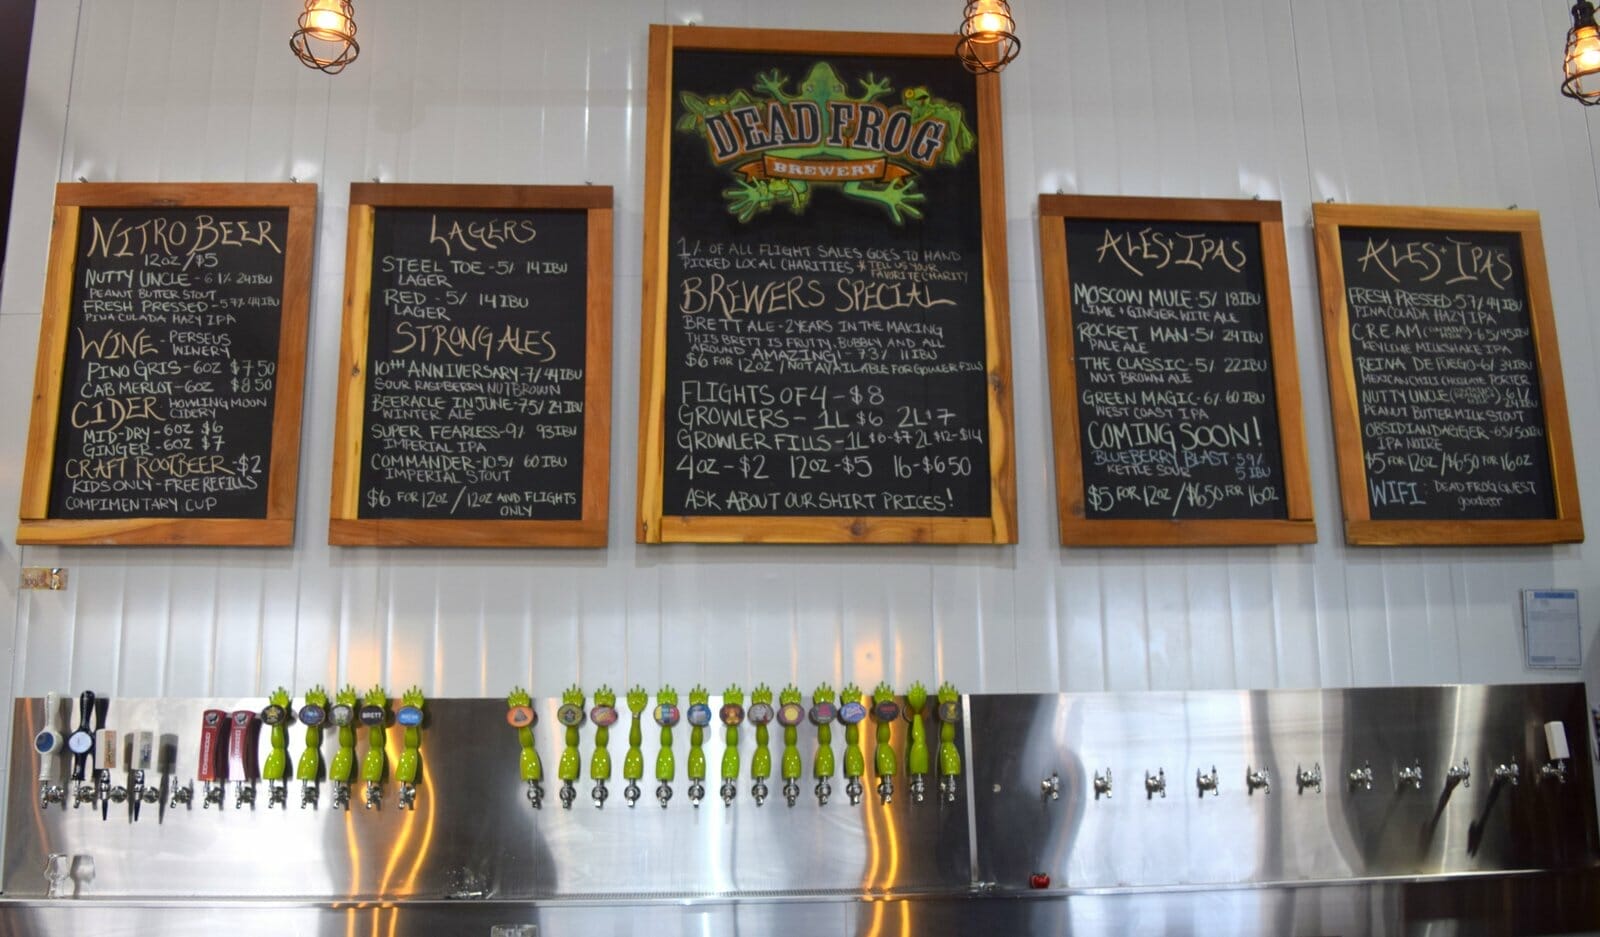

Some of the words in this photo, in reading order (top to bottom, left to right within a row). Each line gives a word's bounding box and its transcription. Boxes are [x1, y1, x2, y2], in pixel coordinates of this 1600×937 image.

[705, 102, 824, 161] DEAD
[827, 102, 946, 162] FROG
[773, 162, 879, 177] BREWERY
[87, 216, 186, 257] NITRO
[185, 215, 282, 256] BEER
[430, 214, 536, 256] LAGERS
[710, 244, 723, 254] OF
[729, 243, 752, 255] ALL
[759, 244, 811, 257] FLIGHT
[816, 246, 862, 258] SALES
[866, 248, 900, 261] GOES
[902, 250, 918, 260] TO
[924, 250, 962, 261] HAND
[1097, 227, 1170, 277] ALES
[1175, 231, 1246, 273] IPAS
[382, 256, 443, 273] STEEL
[451, 261, 485, 274] TOE
[682, 258, 731, 269] PICKED
[735, 258, 775, 269] LOCAL
[781, 259, 854, 273] CHARITIES
[85, 269, 133, 288] NUTTY
[140, 271, 191, 287] UNCLE
[398, 274, 452, 288] LAGER
[90, 290, 132, 299] PEANUT
[138, 290, 179, 299] BUTTER
[183, 290, 216, 300] STOUT
[384, 289, 426, 305] RED
[680, 273, 825, 321] BREWERS
[835, 276, 958, 312] SPECIAL
[1074, 283, 1141, 305] MOSCOW
[1149, 289, 1191, 308] MULE
[1349, 288, 1391, 304] FRESH
[1394, 289, 1451, 309] PRESSED
[83, 300, 132, 312] FRESH
[142, 301, 208, 313] PRESSED
[394, 305, 450, 320] LAGER
[1081, 305, 1115, 318] LIME
[1127, 307, 1174, 321] GINGER
[1213, 312, 1240, 324] ALE
[173, 315, 202, 326] HAZY
[207, 314, 236, 325] IPA
[1388, 307, 1430, 321] COLADA
[1434, 309, 1466, 325] HAZY
[1469, 312, 1497, 324] IPA
[683, 315, 743, 333] BRETT
[747, 321, 775, 332] ALE
[838, 321, 856, 332] IN
[886, 322, 944, 338] MAKING
[1077, 323, 1138, 342] ROCKET
[1151, 327, 1188, 344] MAN
[1352, 324, 1420, 340] CREAM
[78, 327, 159, 360] WINE
[169, 331, 231, 346] PERSEUS
[392, 322, 494, 360] STRONG
[497, 325, 557, 363] ALES
[685, 332, 719, 344] THIS
[721, 335, 761, 347] BRETT
[767, 338, 783, 347] IS
[838, 336, 882, 348] BUBBLY
[886, 338, 916, 348] AND
[922, 338, 946, 348] ALL
[1090, 339, 1120, 352] PALE
[1123, 343, 1149, 354] ALE
[172, 344, 230, 357] WINERY
[690, 344, 745, 354] AROUND
[1486, 345, 1512, 354] IPA
[87, 362, 130, 382] PINO
[134, 361, 181, 381] GRIS
[408, 361, 521, 381] ANNIVERSARY
[685, 352, 708, 368] $6
[713, 356, 733, 366] FOR
[814, 362, 890, 375] AVAILABLE
[1080, 356, 1110, 371] THE
[1116, 357, 1186, 372] CLASSIC
[1356, 356, 1406, 372] REINA
[1412, 356, 1432, 370] DE
[374, 378, 411, 390] SOUR
[1090, 373, 1116, 383] NUT
[1121, 374, 1164, 384] BROWN
[1168, 374, 1192, 383] ALE
[1488, 374, 1531, 386] PORTER
[81, 382, 113, 398] CAB
[119, 382, 173, 395] MERLOT
[681, 381, 775, 404] FLIGHTS
[780, 386, 807, 406] OF
[809, 386, 827, 409] 4
[1083, 389, 1136, 406] GREEN
[1142, 391, 1197, 406] MAGIC
[1363, 390, 1407, 403] NUTTY
[1409, 390, 1449, 402] UNCLE
[169, 398, 229, 410] HOWLING
[231, 398, 267, 407] MOON
[372, 394, 446, 412] BEERACLE
[452, 399, 474, 411] IN
[475, 398, 513, 412] JUNE
[71, 396, 166, 431] CIDER
[170, 408, 216, 419] CIDERY
[382, 410, 441, 420] WINTER
[448, 410, 476, 420] ALE
[678, 404, 789, 430] GROWLERS
[856, 411, 883, 426] $6
[1096, 406, 1129, 418] WEST
[1134, 408, 1173, 418] COAST
[1178, 408, 1209, 419] IPA
[1363, 405, 1408, 417] PEANUT
[1487, 411, 1525, 422] STOUT
[202, 422, 223, 435] $6
[371, 424, 422, 439] SUPER
[431, 425, 500, 439] FEARLESS
[1087, 421, 1178, 451] COMING
[1180, 416, 1262, 450] SOON!
[1366, 423, 1430, 436] OBSIDIAN
[83, 443, 153, 459] GINGER
[202, 436, 225, 451] $7
[383, 439, 452, 452] IMPERIAL
[458, 442, 487, 452] IPA
[677, 430, 772, 452] GROWLER
[775, 434, 831, 451] FILLS
[1377, 437, 1402, 449] IPA
[1407, 437, 1443, 450] NOIRE
[371, 454, 475, 470] COMMANDER
[740, 455, 769, 479] $2
[1093, 450, 1178, 468] BLUEBERRY
[1183, 451, 1229, 468] BLAST
[1388, 457, 1406, 465] FOR
[65, 457, 128, 479] CRAFT
[385, 468, 461, 483] IMPERIAL
[466, 470, 511, 483] STOUT
[1107, 465, 1151, 475] KETTLE
[1156, 465, 1191, 477] SOUR
[72, 479, 112, 493] KIDS
[113, 479, 152, 491] ONLY
[165, 479, 200, 491] FREE
[202, 476, 258, 492] REFILLS
[66, 498, 178, 512] COMPIMENTARY
[185, 498, 217, 511] CUP
[368, 490, 390, 508] $6
[397, 492, 418, 502] FOR
[497, 493, 521, 502] AND
[525, 491, 576, 504] FLIGHTS
[685, 488, 721, 509] ASK
[726, 492, 781, 511] ABOUT
[784, 492, 814, 508] OUR
[819, 493, 876, 509] SHIRT
[884, 488, 953, 511] PRICES!
[1088, 484, 1114, 511] $5
[1117, 486, 1142, 500] FOR
[1225, 486, 1244, 496] FOR
[500, 506, 532, 517] ONLY
